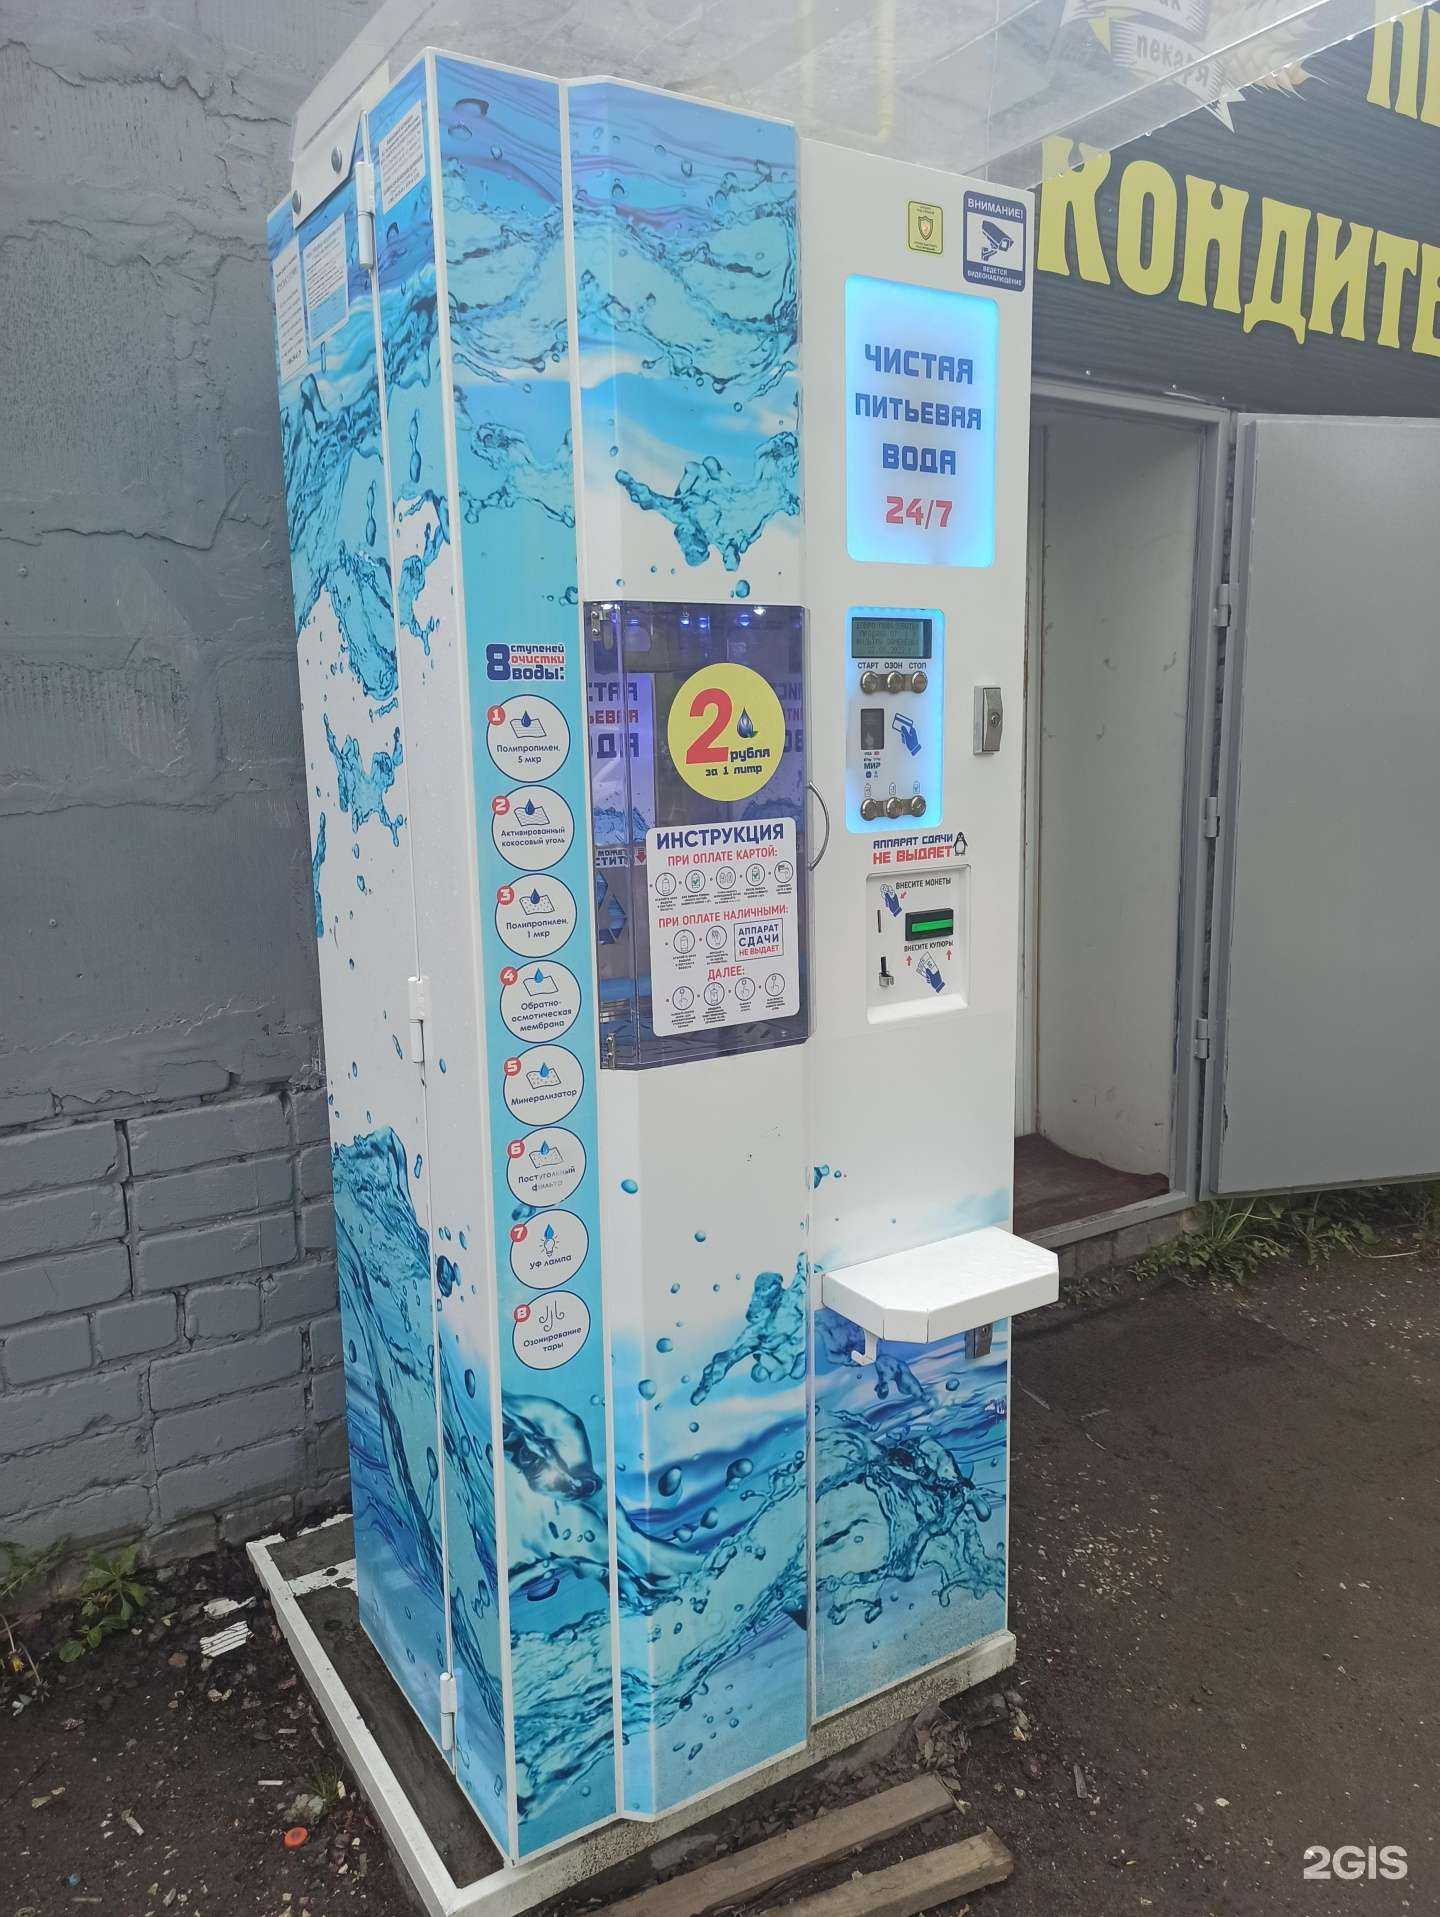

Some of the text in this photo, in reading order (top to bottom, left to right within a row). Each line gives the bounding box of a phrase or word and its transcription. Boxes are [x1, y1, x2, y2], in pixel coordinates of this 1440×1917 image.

[967, 199, 1024, 219] ВНИМАНИЕ!
[864, 343, 973, 384] ЧИСТАЯ
[855, 392, 982, 430] ПИТЬЕВАЯ
[882, 443, 956, 475] ВОДА
[886, 495, 953, 529] 24/7
[511, 644, 564, 654] ступеней
[486, 643, 511, 680] 8
[511, 655, 564, 664] очистки
[512, 664, 565, 680] воды:
[493, 708, 501, 721] 1
[686, 688, 733, 764] 2
[730, 747, 771, 763] рубля
[705, 764, 763, 777] за 1 литр
[495, 799, 506, 811] 2
[657, 823, 784, 850] ИНСТРУКЦИЯ
[873, 833, 953, 849] АППАРАТ СДАЧИ
[668, 845, 778, 867] ПРИ ОПЛАТЕ КАРТОЙ:
[873, 845, 953, 865] НЕ ВЫДАЕТ
[895, 877, 952, 890] ВНЕСИТЕ МОНЕТЫ
[658, 904, 789, 929] ПРИ ОПЛАТЕ НАЛИЧНЫМИ:
[738, 924, 779, 936] АППАРАТ
[738, 934, 779, 947] СДАЧИ
[903, 940, 954, 952] ВНЕСИТЕ КУПЮРЫ
[739, 945, 780, 957] НЕ ВЫДАЕТ
[504, 969, 514, 982] 4
[707, 965, 746, 981] ДАЛЕЕ:
[507, 1060, 518, 1073] 5
[511, 1089, 577, 1105] Минерализатор
[514, 1228, 524, 1238] 7
[544, 1255, 572, 1266] лампа
